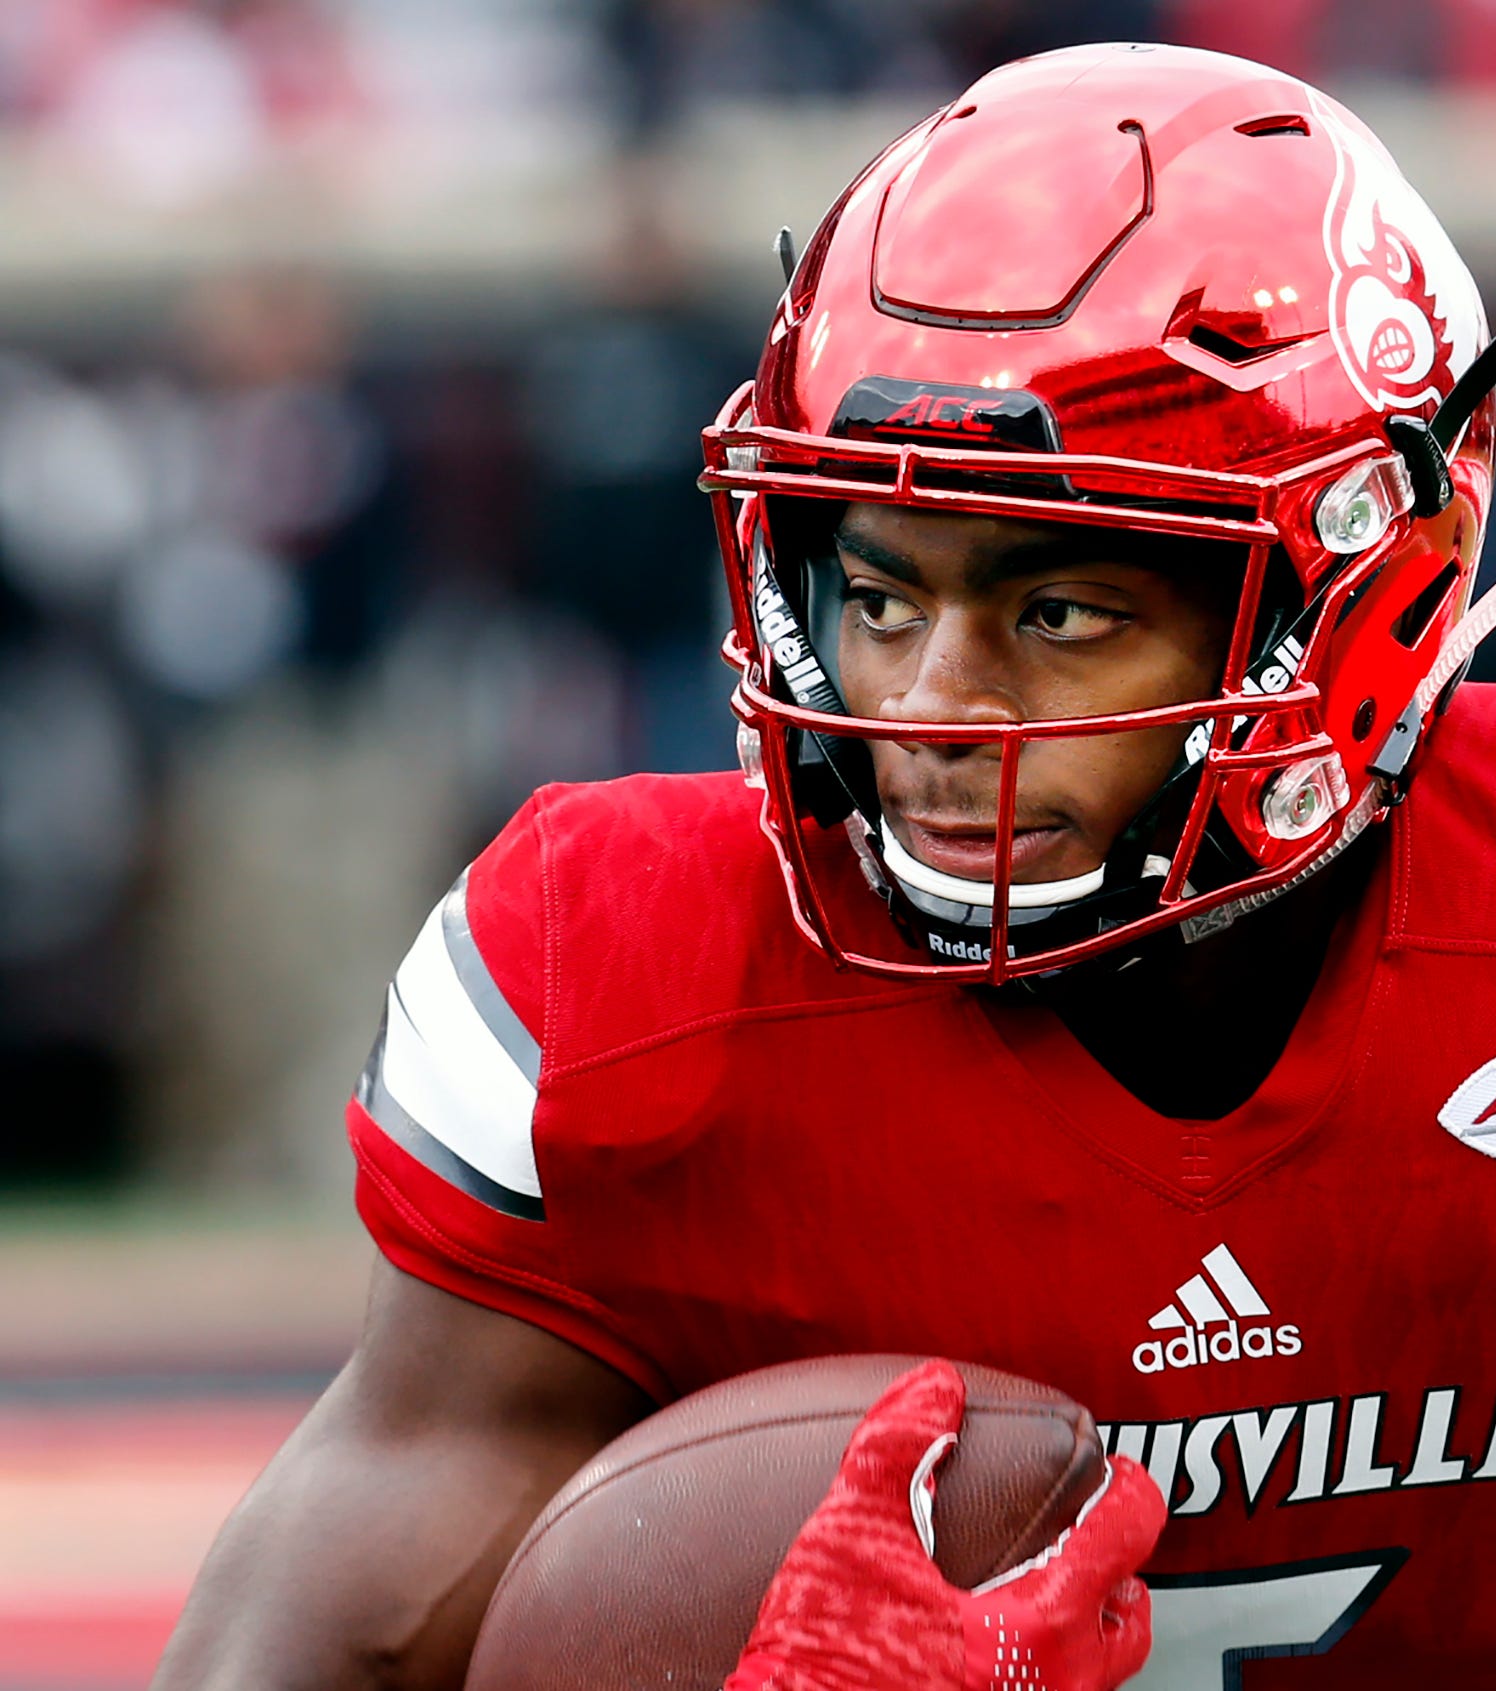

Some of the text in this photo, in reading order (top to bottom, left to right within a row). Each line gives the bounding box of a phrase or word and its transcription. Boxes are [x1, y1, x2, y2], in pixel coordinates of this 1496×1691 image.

[884, 394, 1004, 433] ACC
[928, 932, 1016, 961] Riddel
[1132, 1319, 1302, 1374] adidas
